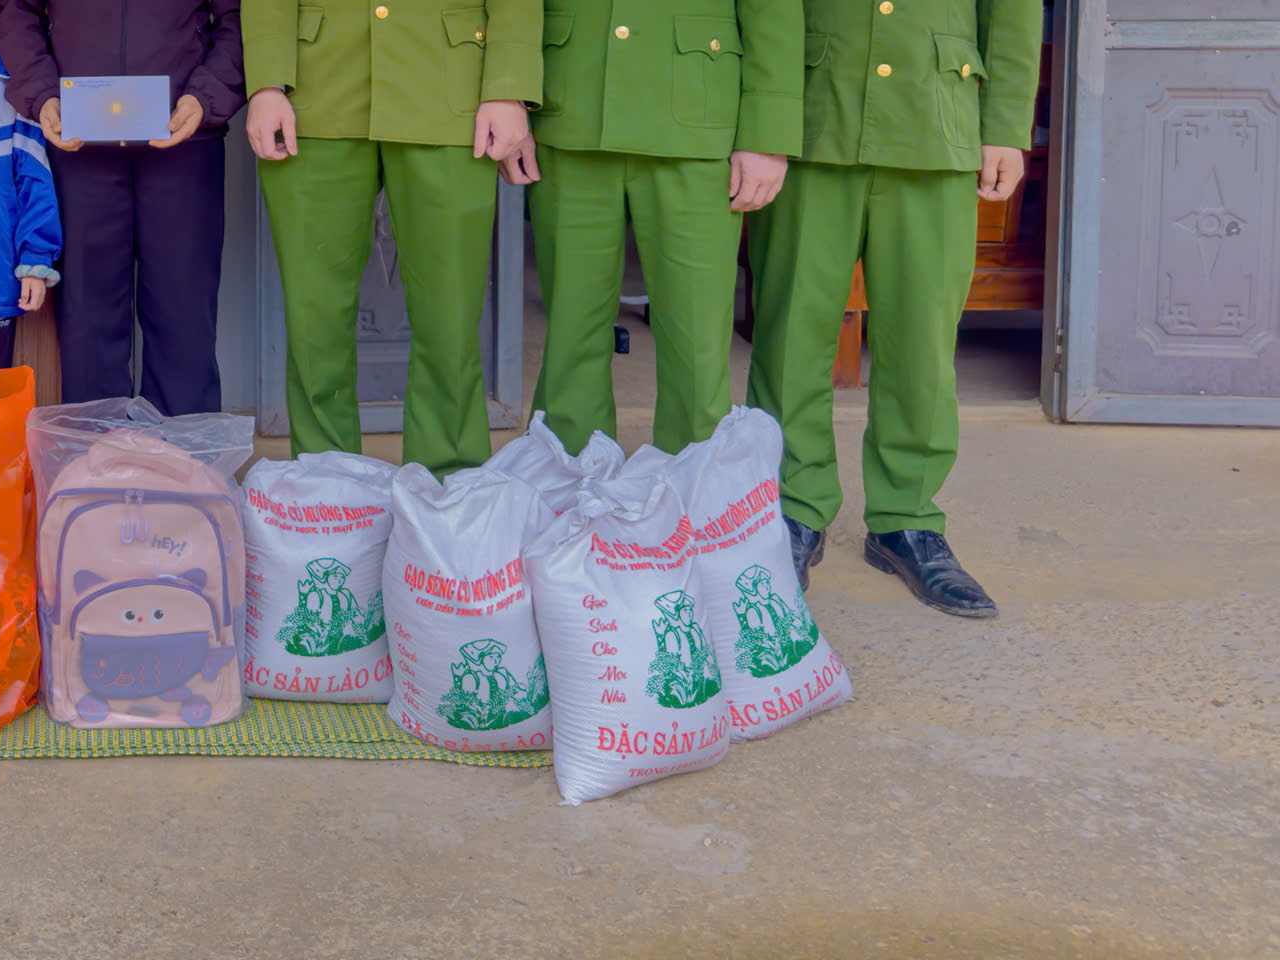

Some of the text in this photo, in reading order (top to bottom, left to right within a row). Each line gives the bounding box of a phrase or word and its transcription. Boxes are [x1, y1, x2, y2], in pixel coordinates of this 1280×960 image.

[404, 563, 425, 592] GẠO
[425, 569, 456, 601] SÉNG
[457, 575, 471, 603] CÙ
[471, 568, 506, 602] MƯỜNG
[591, 640, 618, 656] Cho
[243, 653, 394, 693] ẶC SẢN LÀO CA
[727, 699, 760, 733] ẶC
[762, 686, 803, 721] SẢN
[804, 665, 834, 703] LÀO
[499, 732, 547, 750] LÀO
[597, 715, 727, 760] ĐẶC SẢN LÀO
